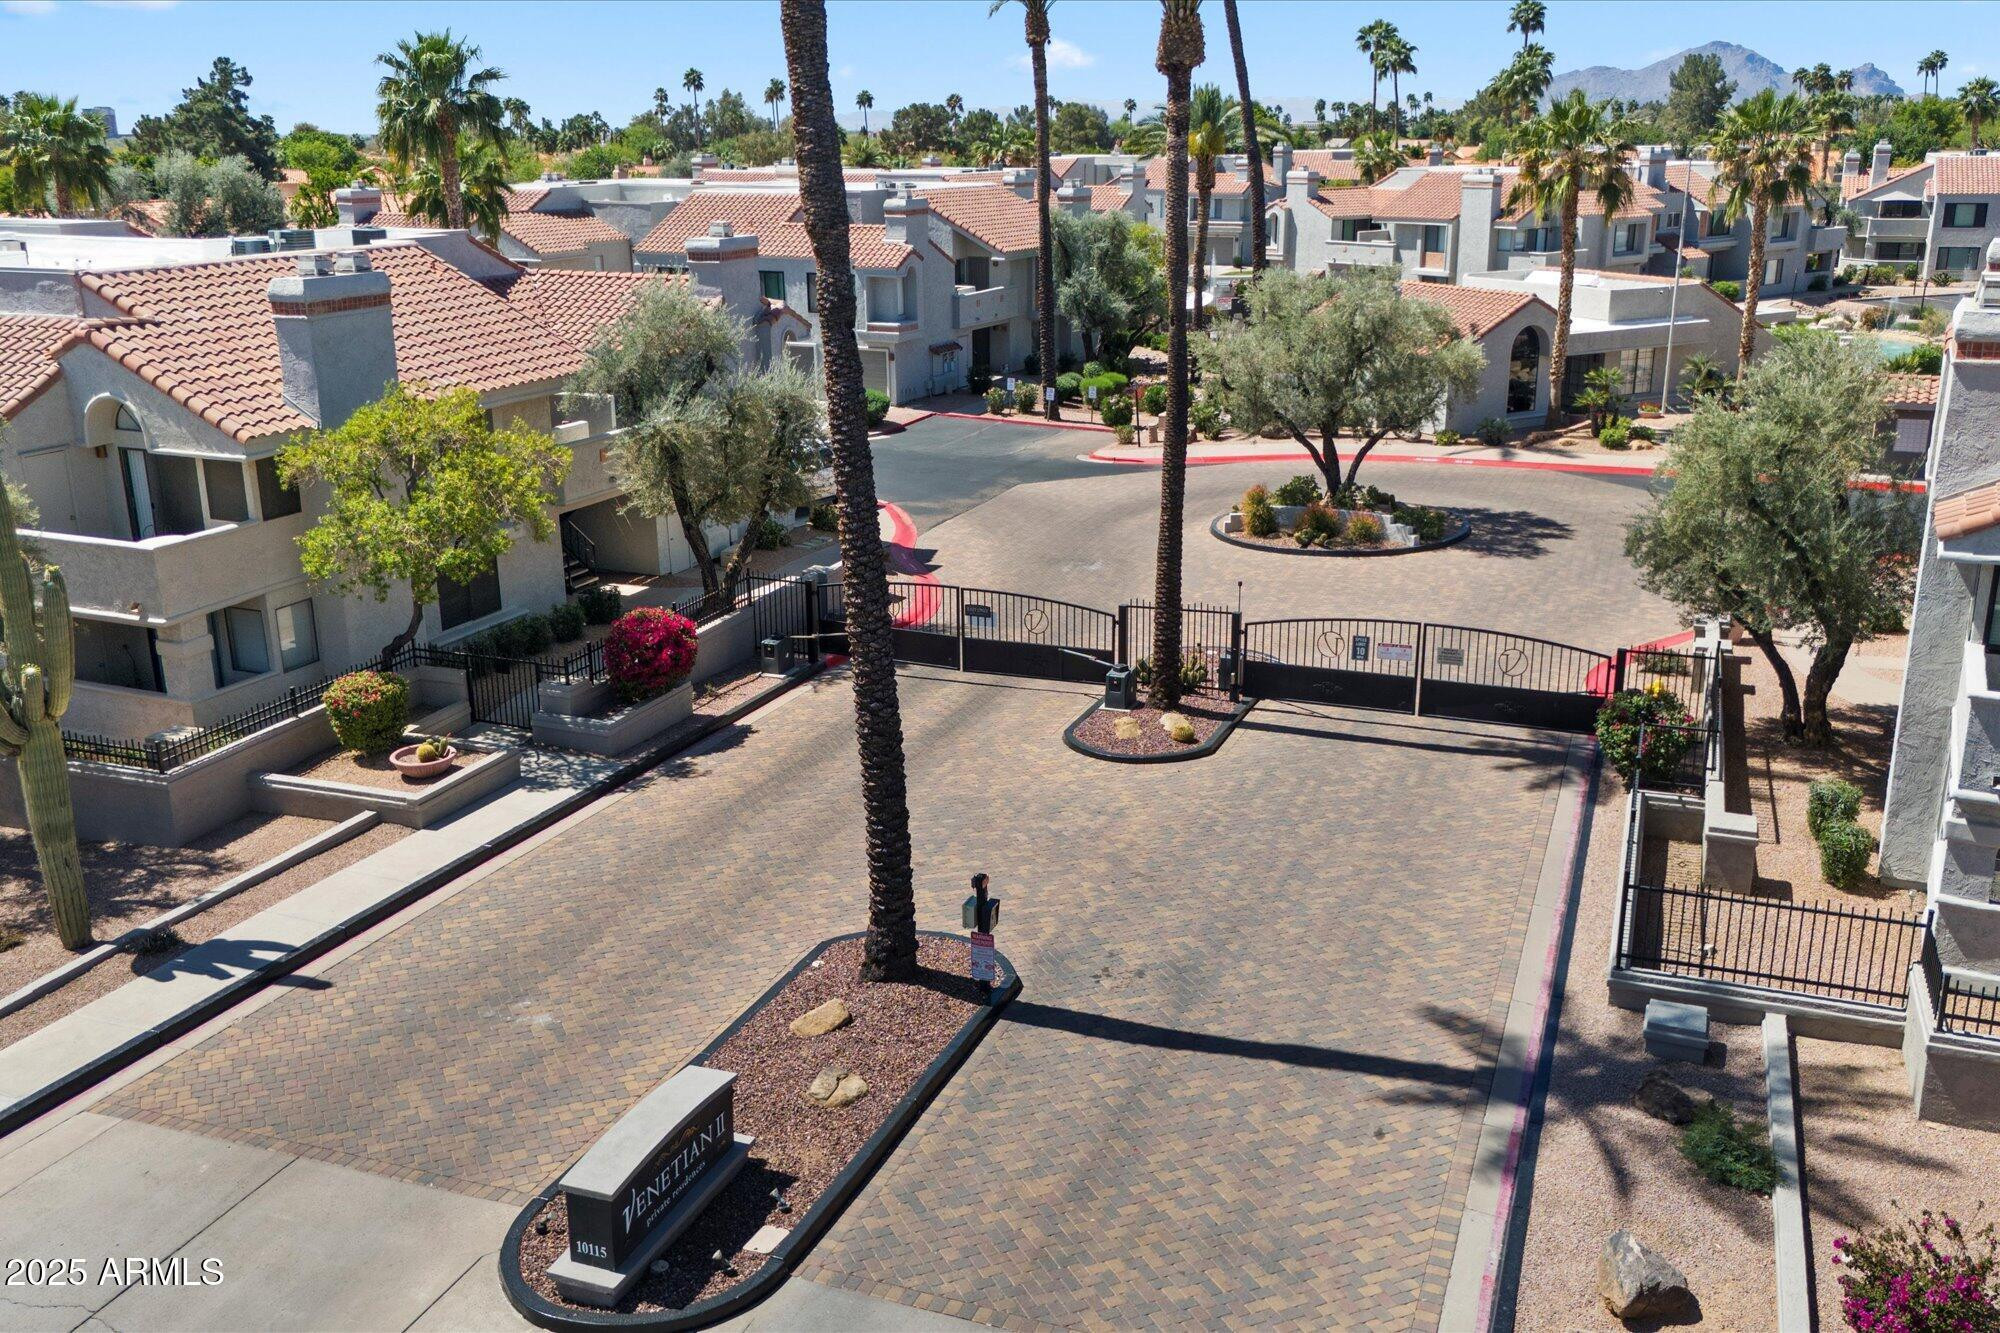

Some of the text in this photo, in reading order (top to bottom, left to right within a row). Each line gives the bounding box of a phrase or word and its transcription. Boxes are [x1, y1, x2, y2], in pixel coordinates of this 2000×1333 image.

[1356, 647, 1366, 656] 10
[622, 1111, 726, 1234] VENETIAN II
[646, 1161, 706, 1228] private residences
[576, 1240, 608, 1259] 10115
